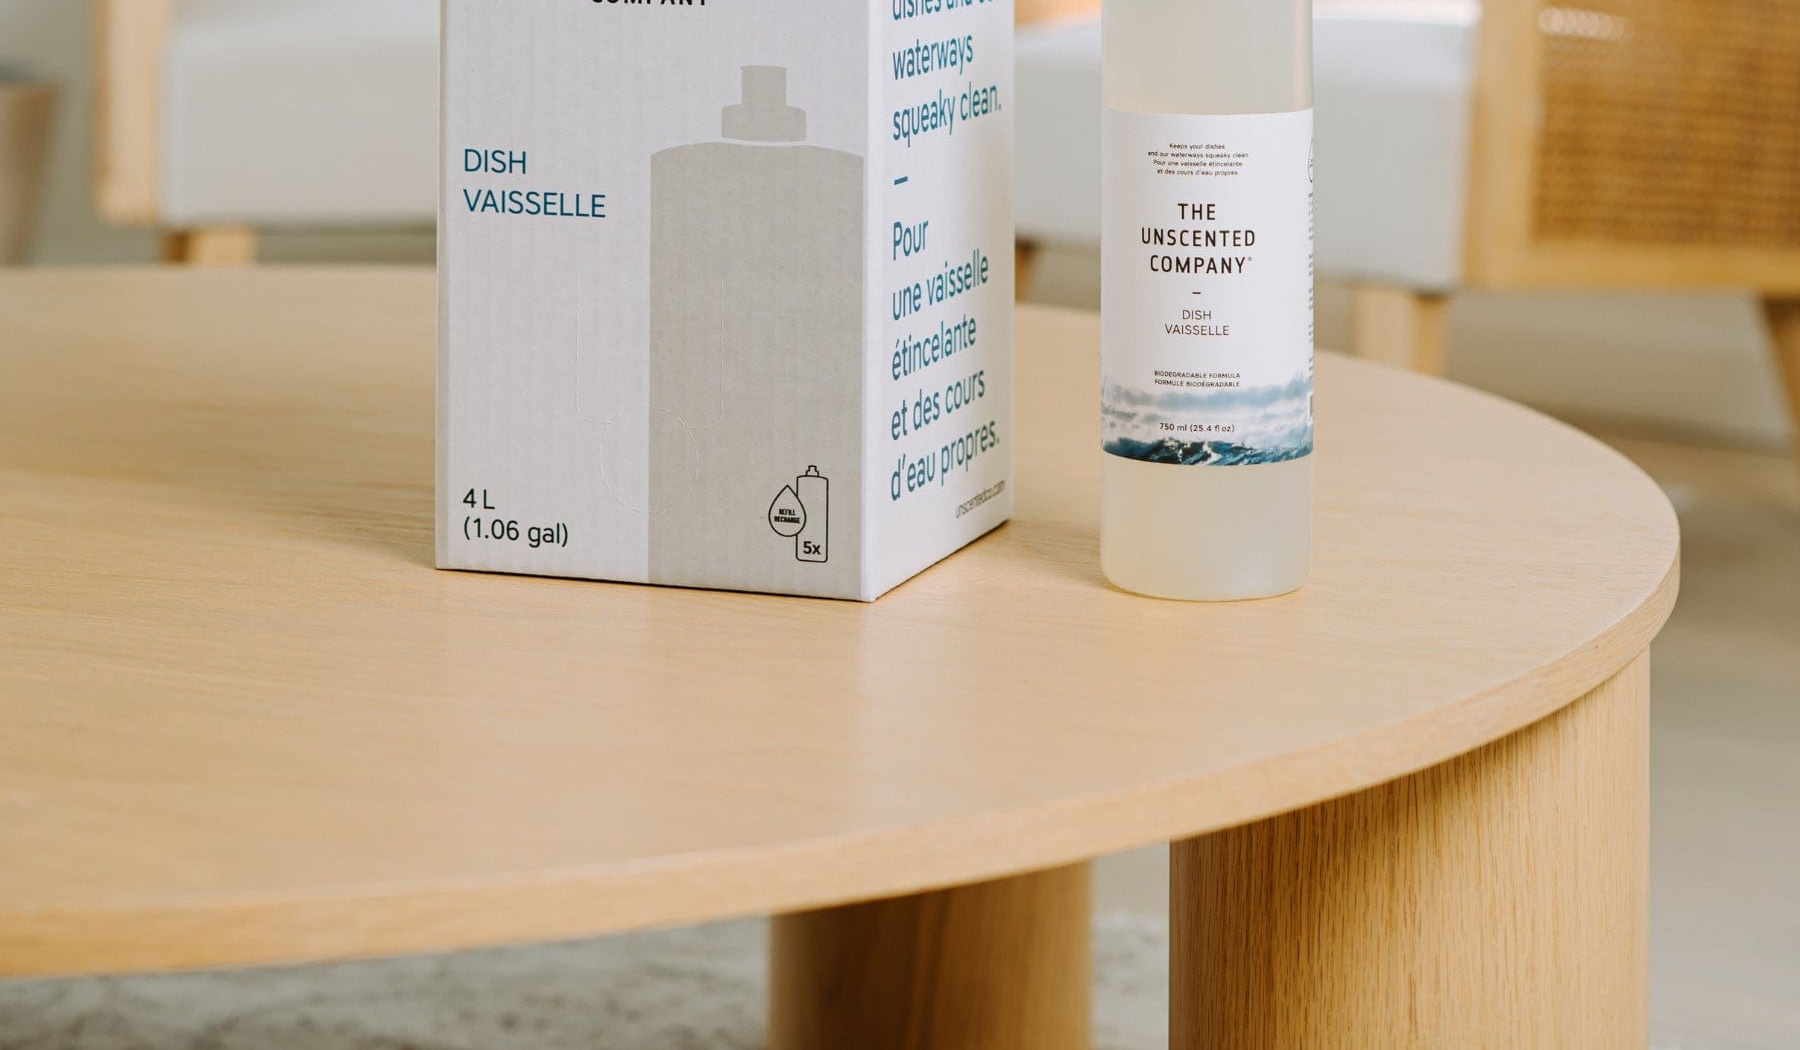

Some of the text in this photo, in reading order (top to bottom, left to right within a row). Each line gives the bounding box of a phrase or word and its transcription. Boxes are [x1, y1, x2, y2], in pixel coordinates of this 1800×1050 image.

[893, 34, 973, 80] waterways
[893, 82, 1001, 147] squeaky clean.
[464, 149, 527, 173] DISH
[463, 190, 606, 218] VAISSELLE
[1178, 203, 1215, 220] THE
[893, 220, 928, 261] Pour
[1141, 227, 1255, 247] UNSCENTED
[893, 249, 988, 321] une vaisselle
[1182, 309, 1211, 320] DISH
[1165, 324, 1229, 336] VAISSELLE
[892, 314, 976, 381] étincelante
[891, 369, 985, 440] et des cours
[1159, 422, 1175, 430] 750
[1190, 424, 1212, 432] (25.4
[1221, 424, 1235, 432] oz)
[891, 420, 1000, 501] d'eau propres.
[463, 488, 495, 510] 4 L
[464, 516, 568, 548] (1.06 gal)
[803, 541, 821, 555] 5x
